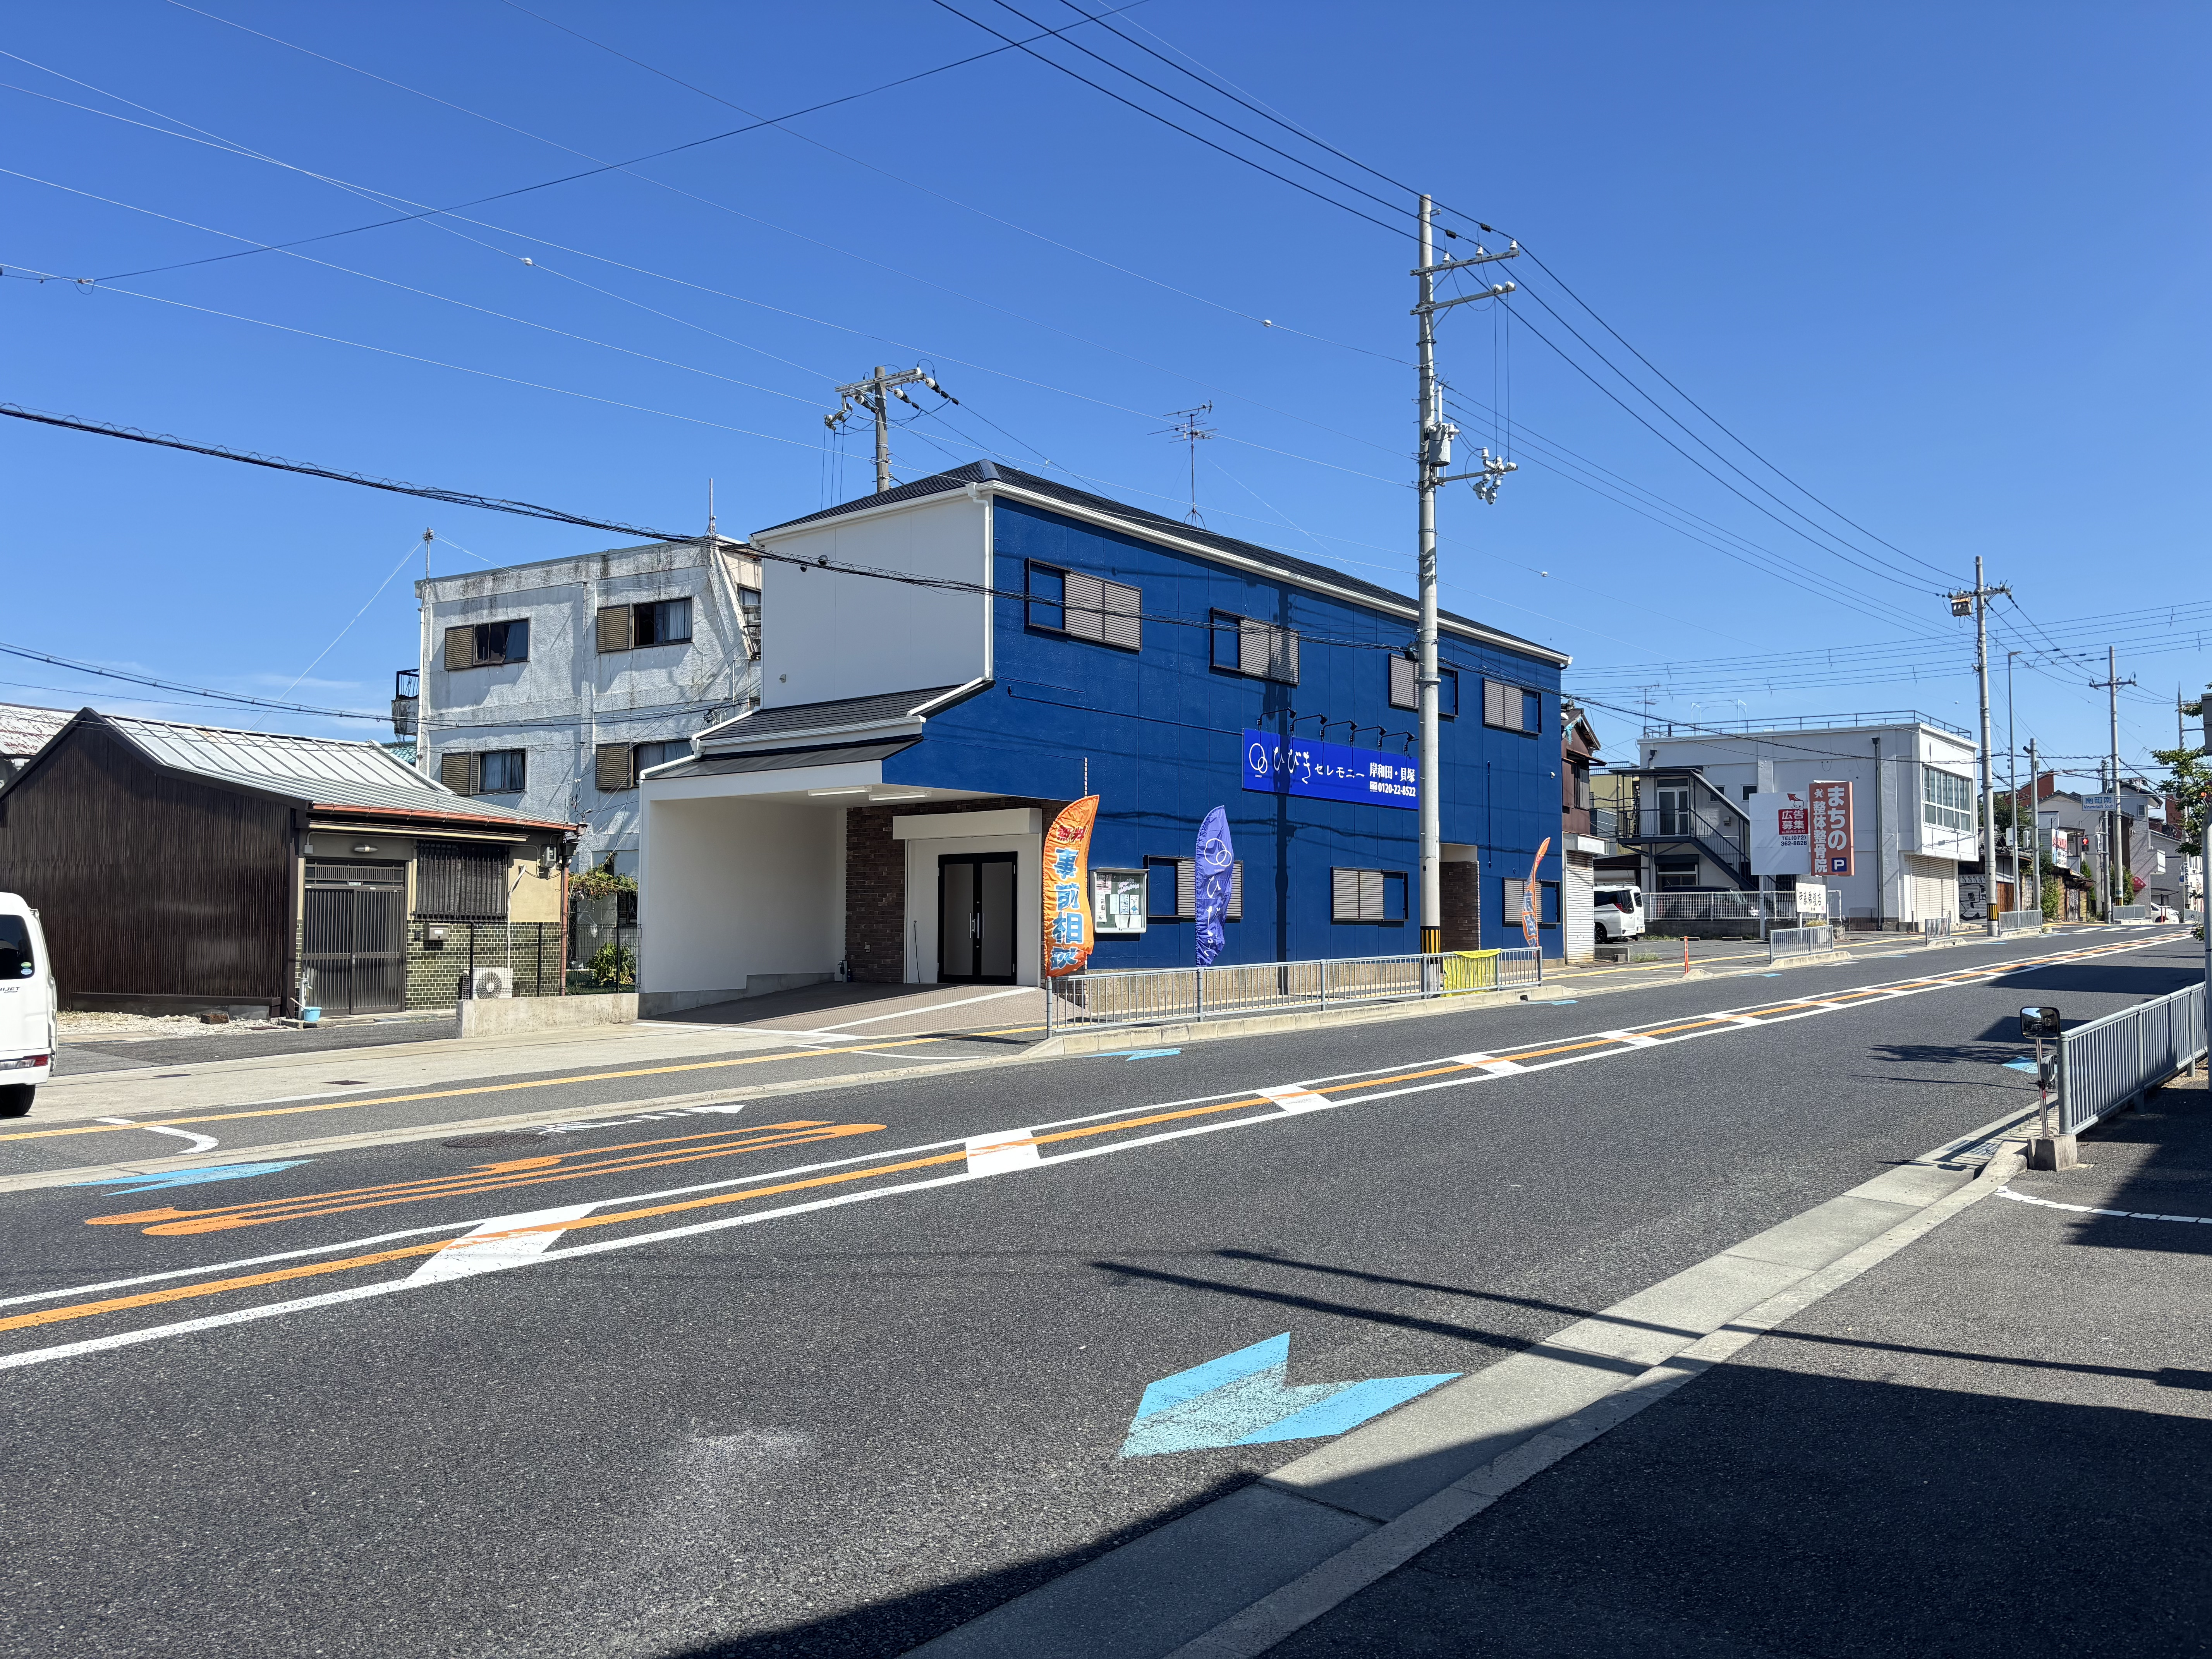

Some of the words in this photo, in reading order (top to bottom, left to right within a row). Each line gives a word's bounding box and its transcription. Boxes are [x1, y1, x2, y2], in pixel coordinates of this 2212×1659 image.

[1369, 762, 1415, 783] 岸和田・貝塚
[1378, 782, 1416, 797] 0120-22-8522
[2085, 796, 2112, 804] 南町南
[1782, 810, 1805, 820] 広告
[1827, 786, 1847, 850] まちの
[1782, 820, 1805, 830] 募集
[1056, 824, 1087, 844] 無料
[1813, 800, 1827, 873] 整体整骨院
[1834, 859, 1844, 870] P
